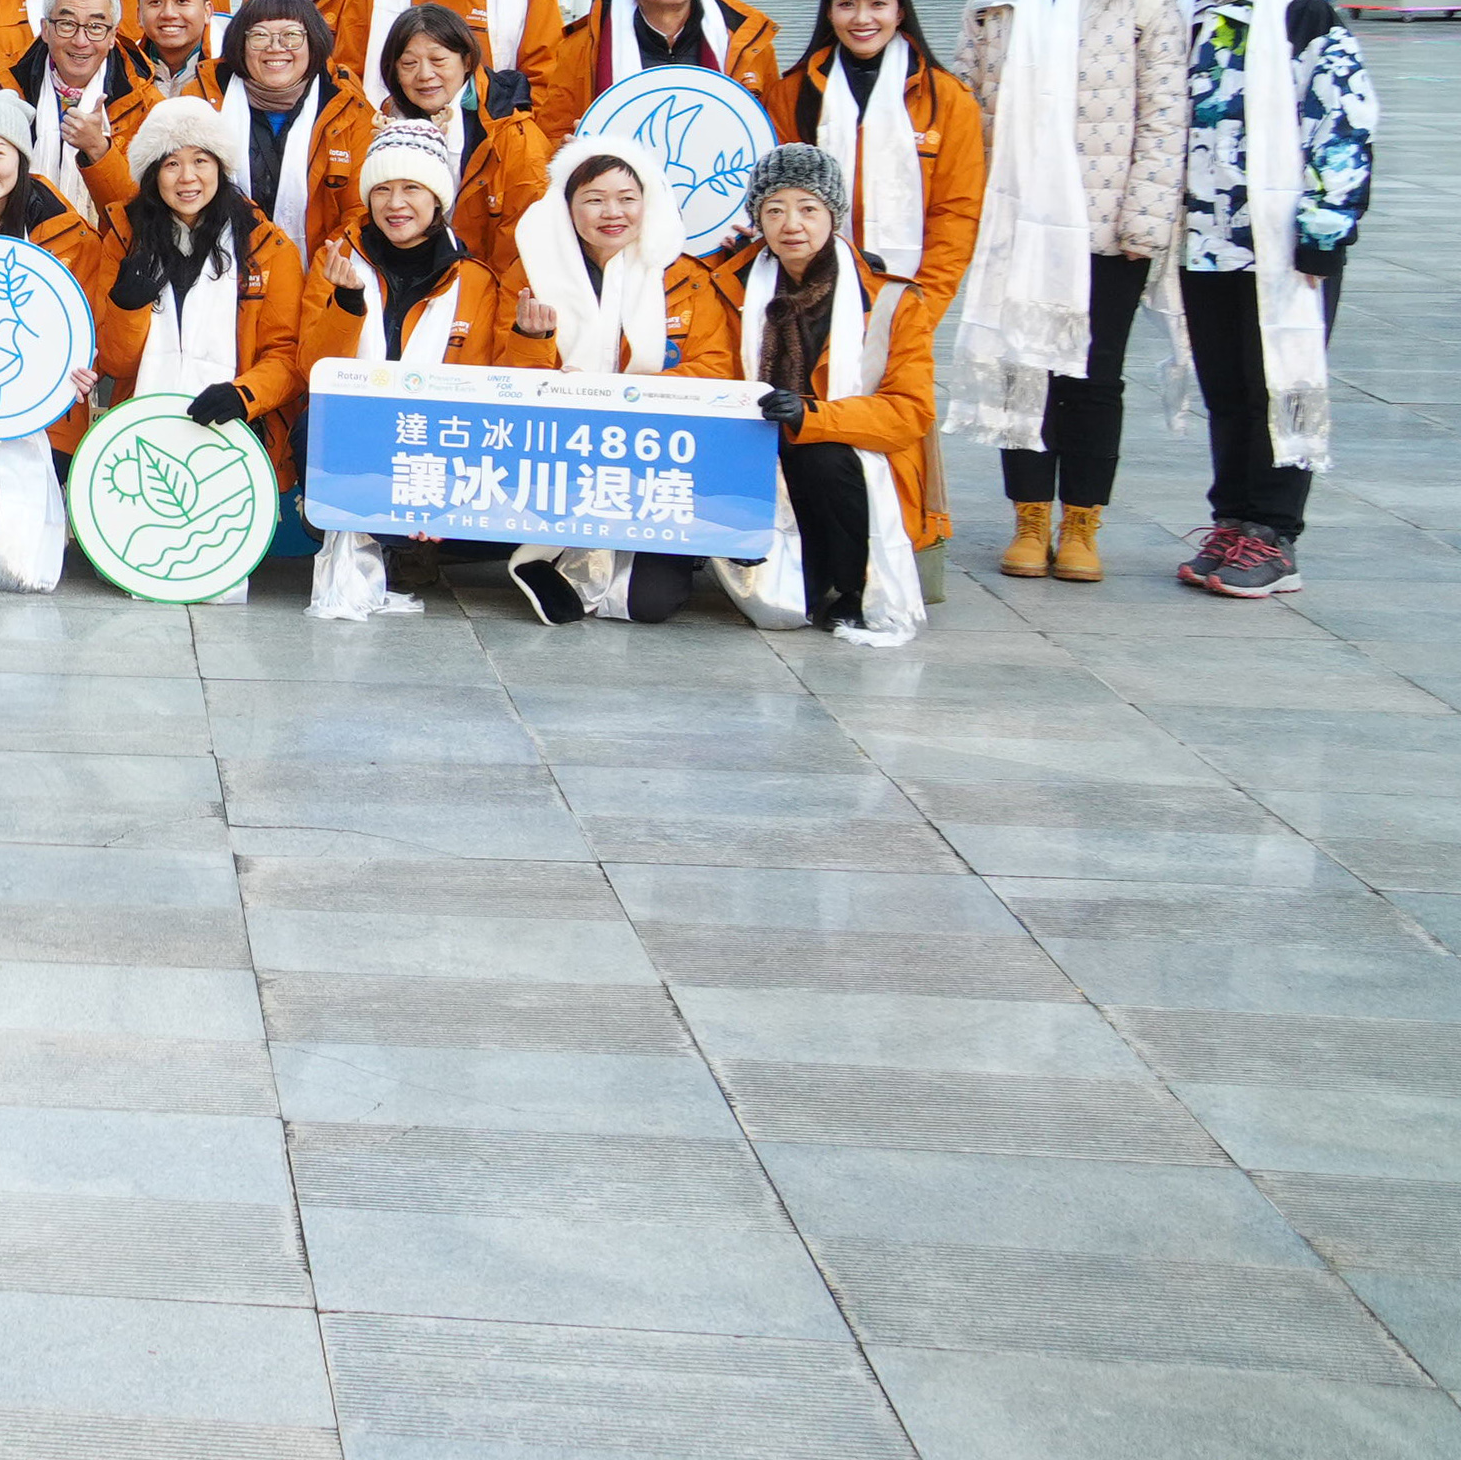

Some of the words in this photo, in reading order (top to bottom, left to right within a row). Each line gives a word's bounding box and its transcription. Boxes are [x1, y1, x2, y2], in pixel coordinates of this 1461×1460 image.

[337, 370, 369, 382] Rotary
[487, 375, 511, 383] UNITE
[498, 391, 523, 399] GOOD
[550, 386, 573, 395] WILL
[576, 387, 612, 397] LEGEND
[395, 411, 696, 466] 達古冰川4860
[390, 451, 695, 525] 讓冰川退燒
[390, 510, 431, 524] LET
[447, 513, 489, 529] THE
[505, 518, 610, 538] GLACIER
[626, 526, 690, 543] COOL
